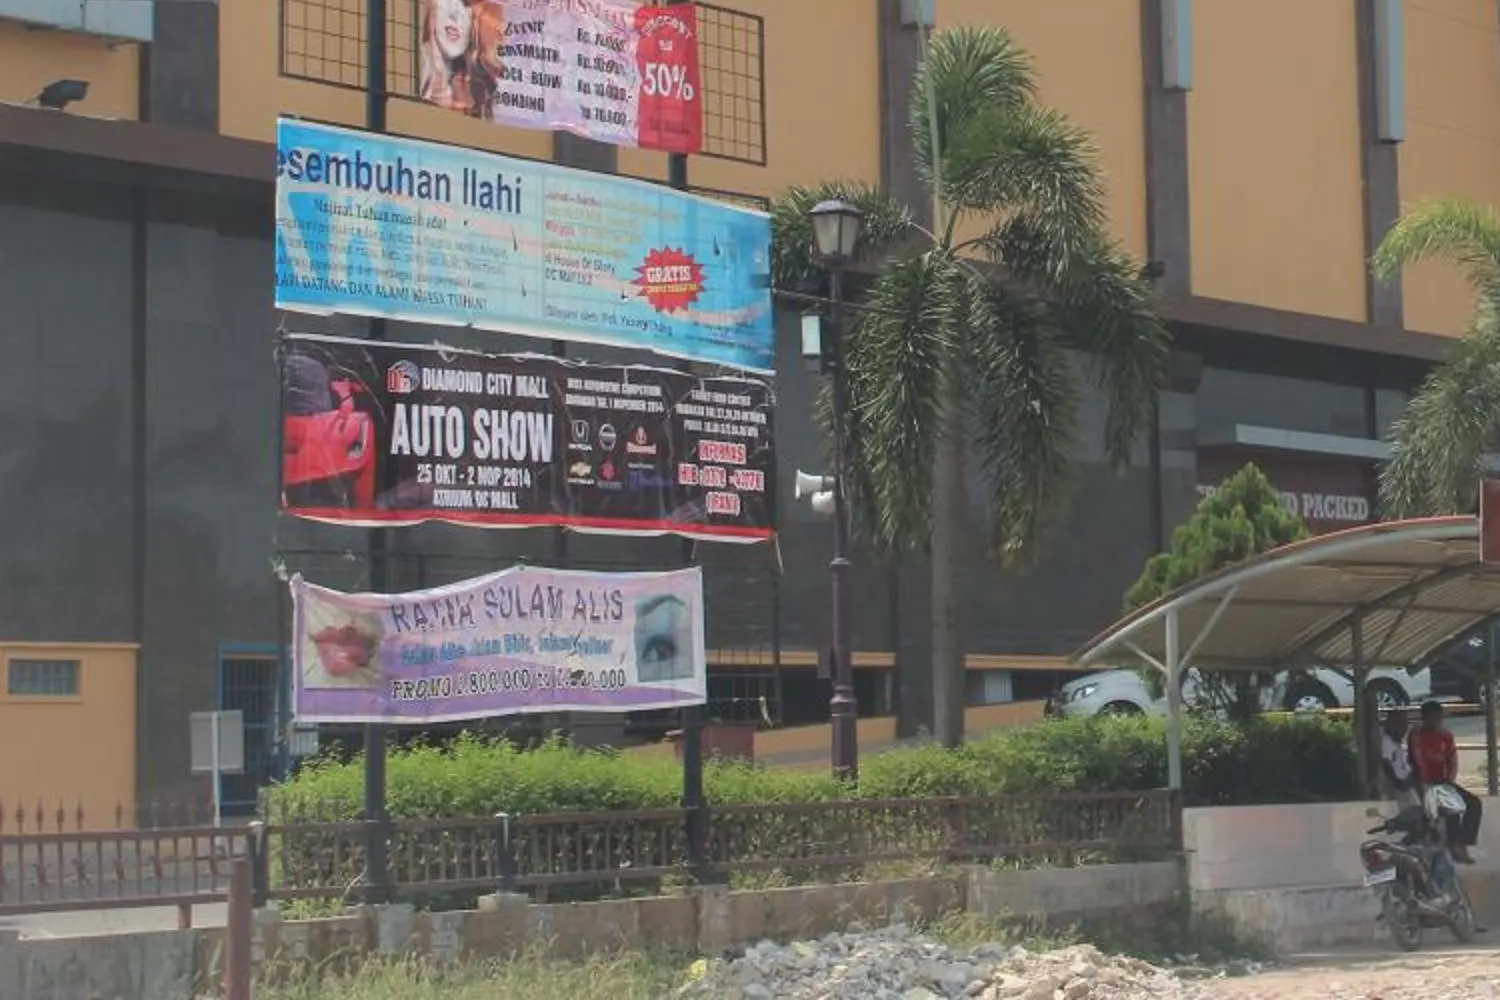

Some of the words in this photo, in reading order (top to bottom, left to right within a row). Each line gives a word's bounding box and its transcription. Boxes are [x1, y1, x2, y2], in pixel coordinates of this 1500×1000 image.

[643, 61, 694, 101] 50%
[647, 265, 691, 283] GRATIS
[421, 367, 483, 394] DIAMOND
[486, 372, 513, 397] CITY
[515, 374, 549, 399] MALL
[390, 402, 465, 460] AUTO
[473, 407, 553, 463] SHOW
[417, 464, 431, 483] 25
[434, 463, 457, 485] OKT
[467, 465, 475, 486] 2
[503, 467, 531, 489] 2014
[1302, 494, 1368, 520] PACKED
[483, 584, 564, 620] SULAM
[571, 589, 623, 621] ALIS
[392, 676, 451, 700] PROMO
